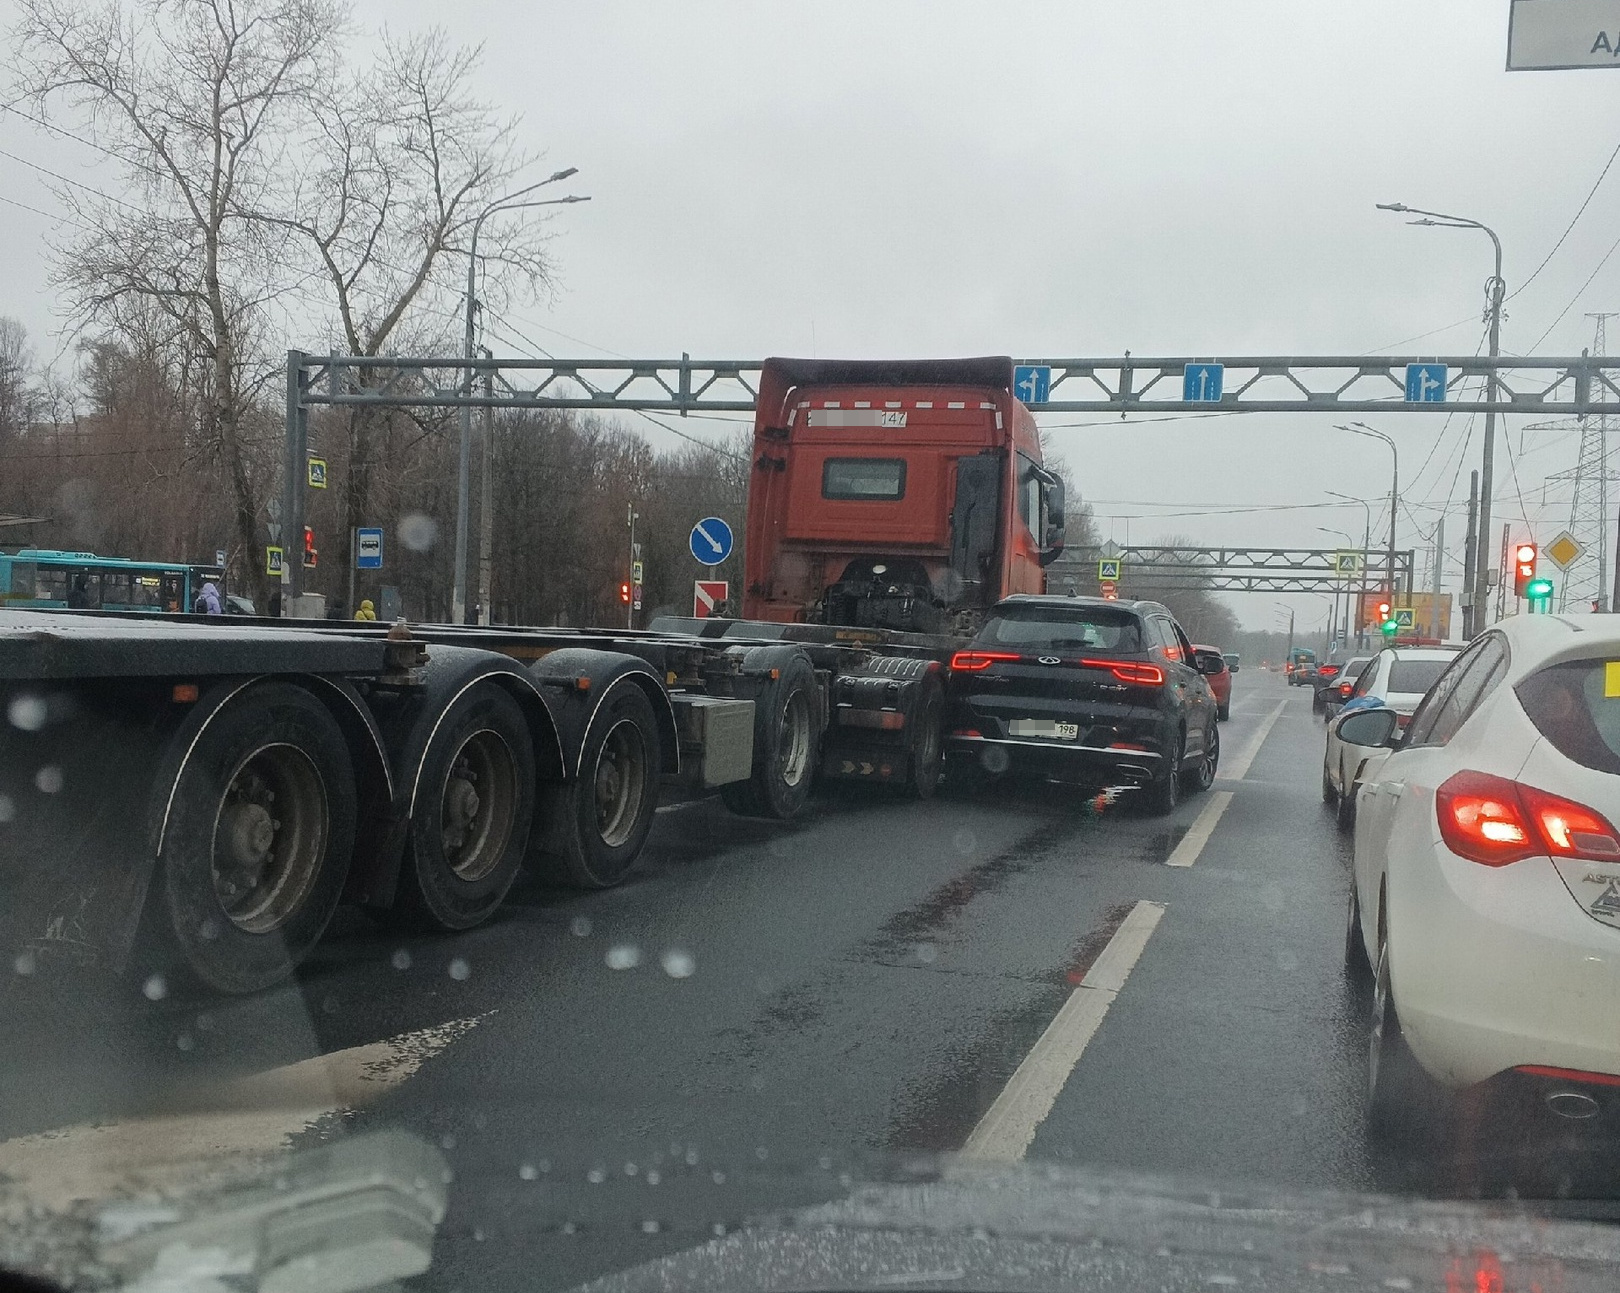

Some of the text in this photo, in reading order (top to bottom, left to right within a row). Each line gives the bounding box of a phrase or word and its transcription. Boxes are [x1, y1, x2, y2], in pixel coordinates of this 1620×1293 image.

[1590, 30, 1620, 58] А
[1058, 725, 1075, 735] 198
[1582, 873, 1620, 887] AST
